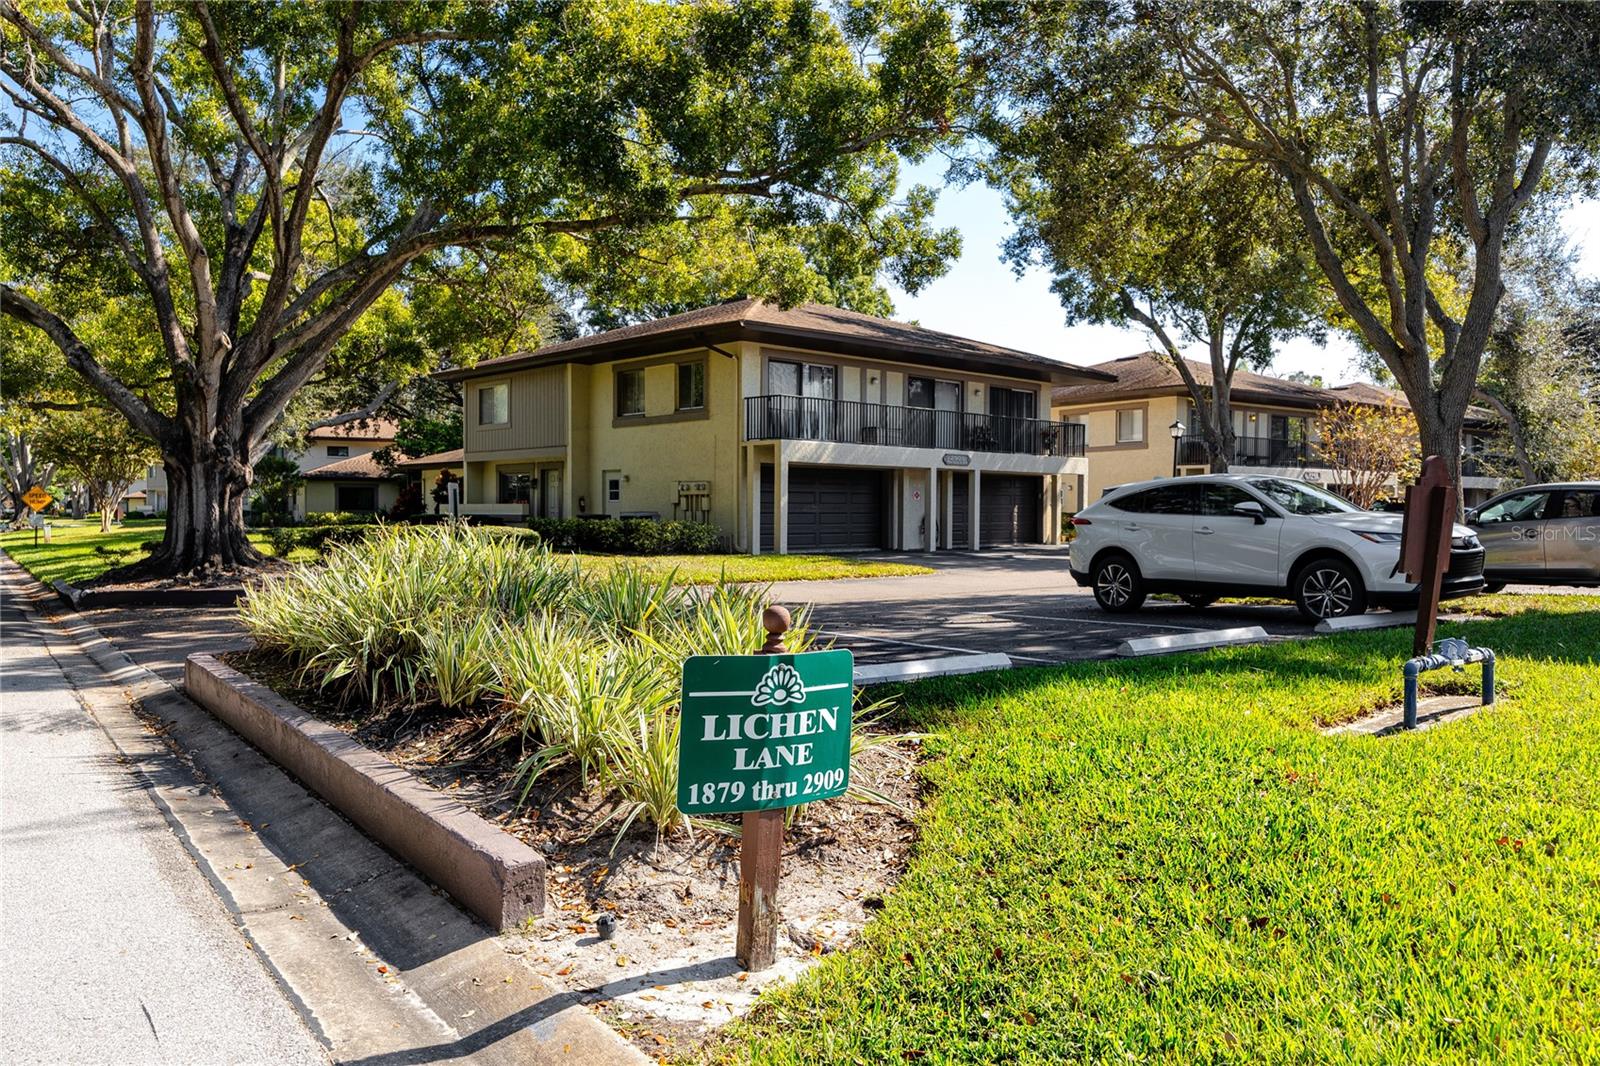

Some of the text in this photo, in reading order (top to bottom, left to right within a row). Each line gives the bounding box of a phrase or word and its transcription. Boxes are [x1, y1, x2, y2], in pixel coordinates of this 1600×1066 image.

[700, 706, 839, 741] LICHEN
[733, 743, 813, 771] LANE
[687, 768, 844, 805] 1879 thru 2909
